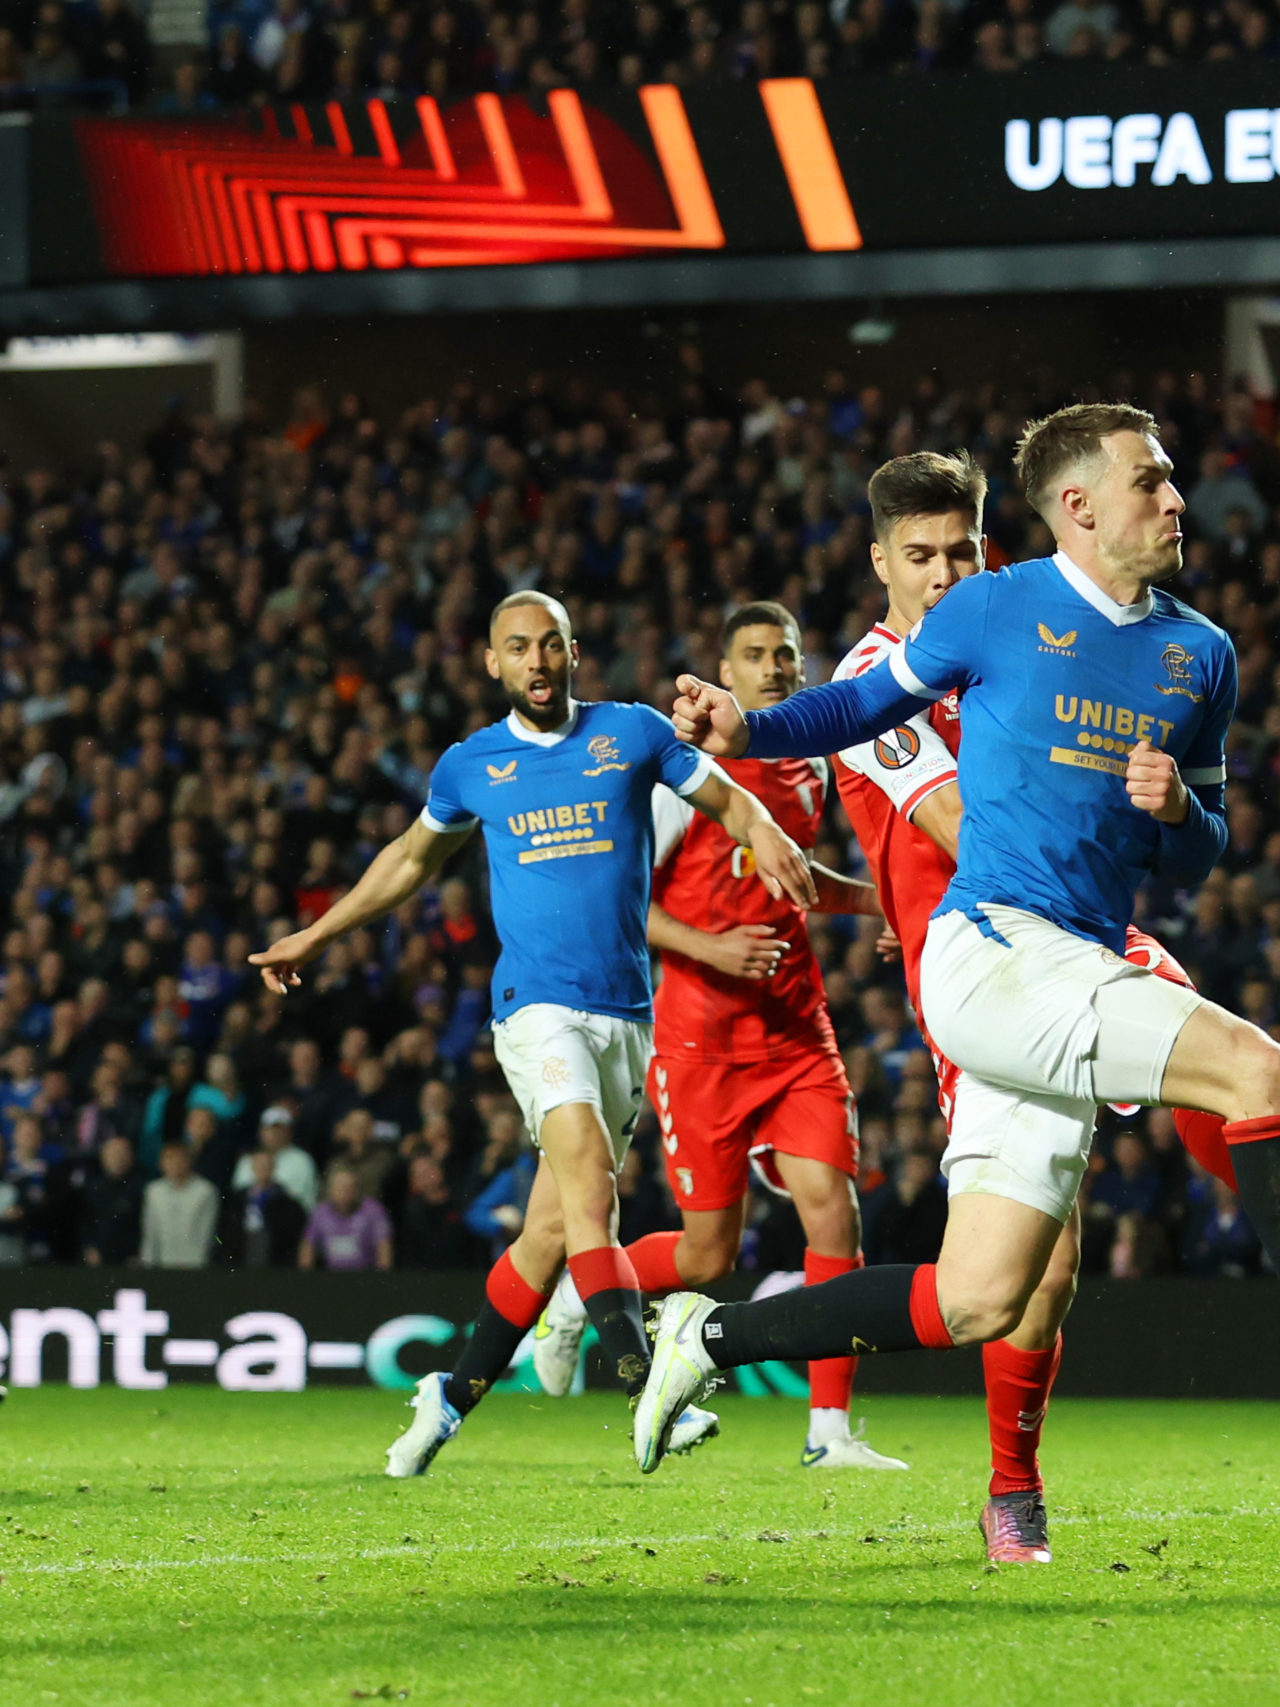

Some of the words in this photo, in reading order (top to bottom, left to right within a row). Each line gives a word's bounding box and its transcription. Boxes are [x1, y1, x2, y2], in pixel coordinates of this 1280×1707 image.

[1005, 112, 1212, 191] UEFA
[1055, 694, 1175, 748] UNIBET
[507, 801, 608, 836] UNIBET
